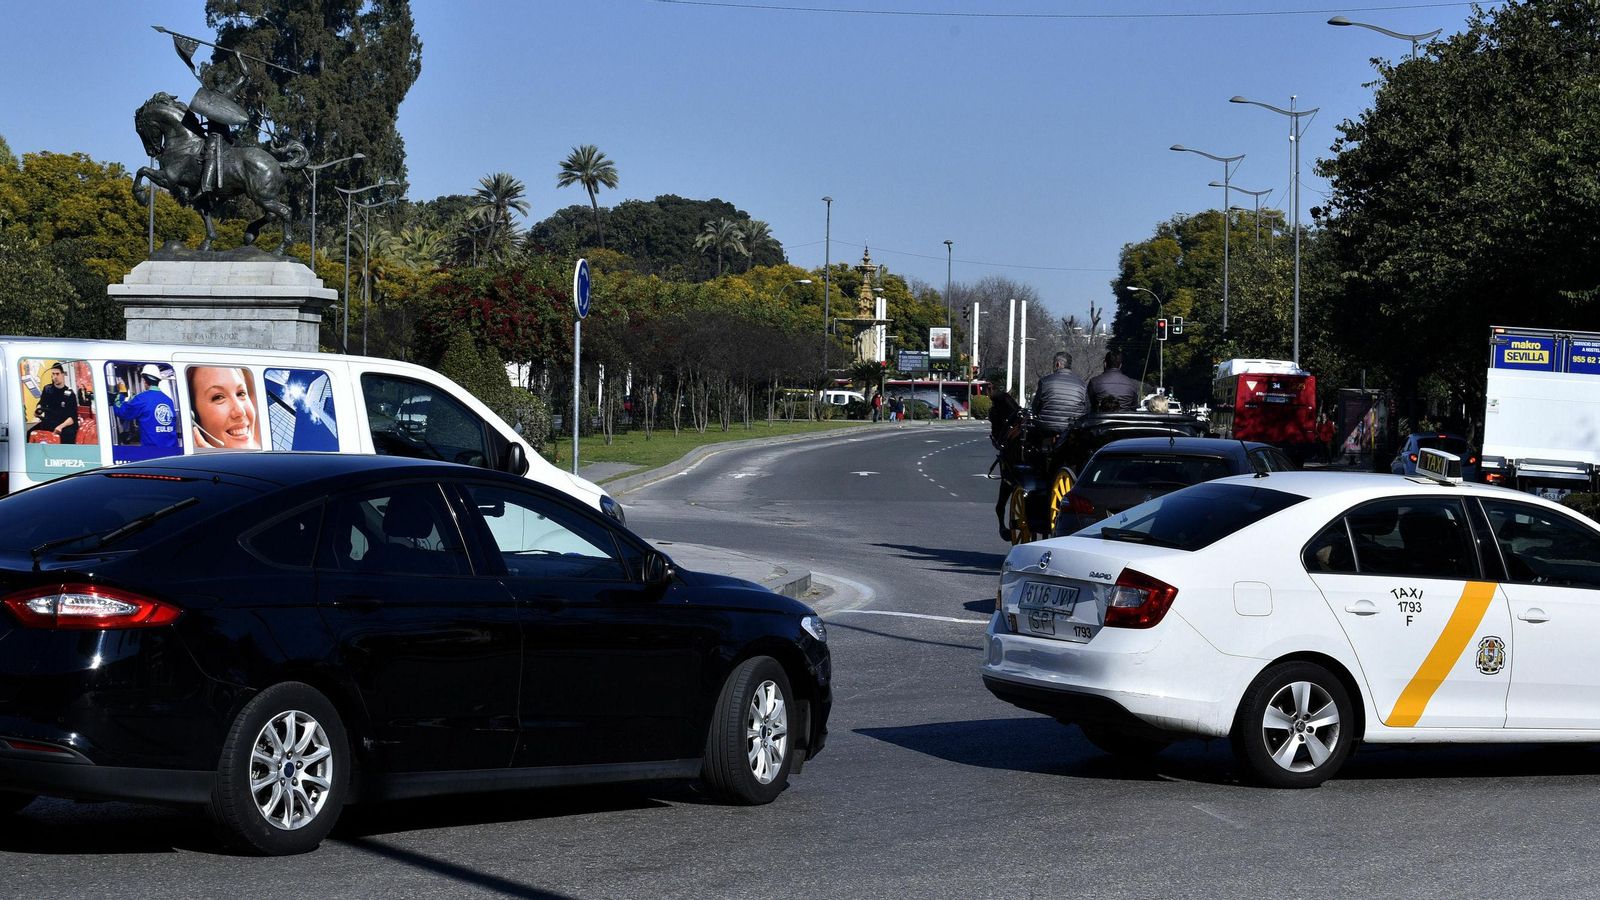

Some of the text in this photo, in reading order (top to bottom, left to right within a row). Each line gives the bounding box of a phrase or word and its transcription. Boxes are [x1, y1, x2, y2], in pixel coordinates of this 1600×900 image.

[1511, 340, 1541, 350] makro
[1506, 351, 1544, 361] SEVILLA
[1572, 355, 1586, 363] 955
[1587, 356, 1596, 364] 62
[44, 458, 86, 468] LIMPIEZA
[1426, 453, 1444, 475] TAXI
[1089, 571, 1112, 580] RAPID
[1390, 587, 1424, 600] TAXI
[1397, 601, 1422, 613] 1793
[1031, 611, 1050, 631] SP
[1406, 615, 1413, 627] F
[1073, 625, 1092, 638] 1793
